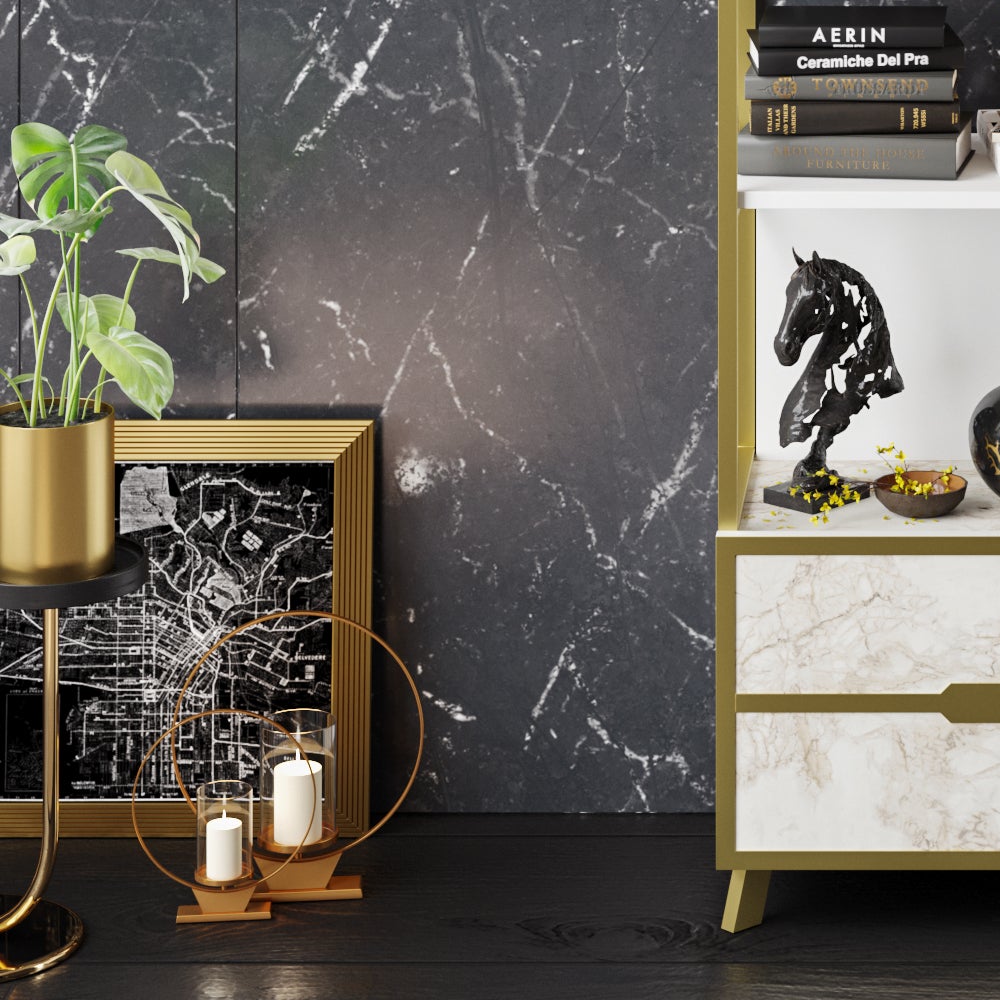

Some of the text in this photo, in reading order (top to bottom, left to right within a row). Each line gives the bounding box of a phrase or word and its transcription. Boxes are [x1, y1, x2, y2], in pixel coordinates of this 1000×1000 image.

[812, 27, 886, 44] AERIN
[796, 52, 929, 69] Ceramiche Del Pra
[812, 77, 928, 92] TOWNSEND
[772, 146, 834, 158] AROUND
[840, 148, 868, 158] THE
[806, 160, 890, 170] FURNITURE
